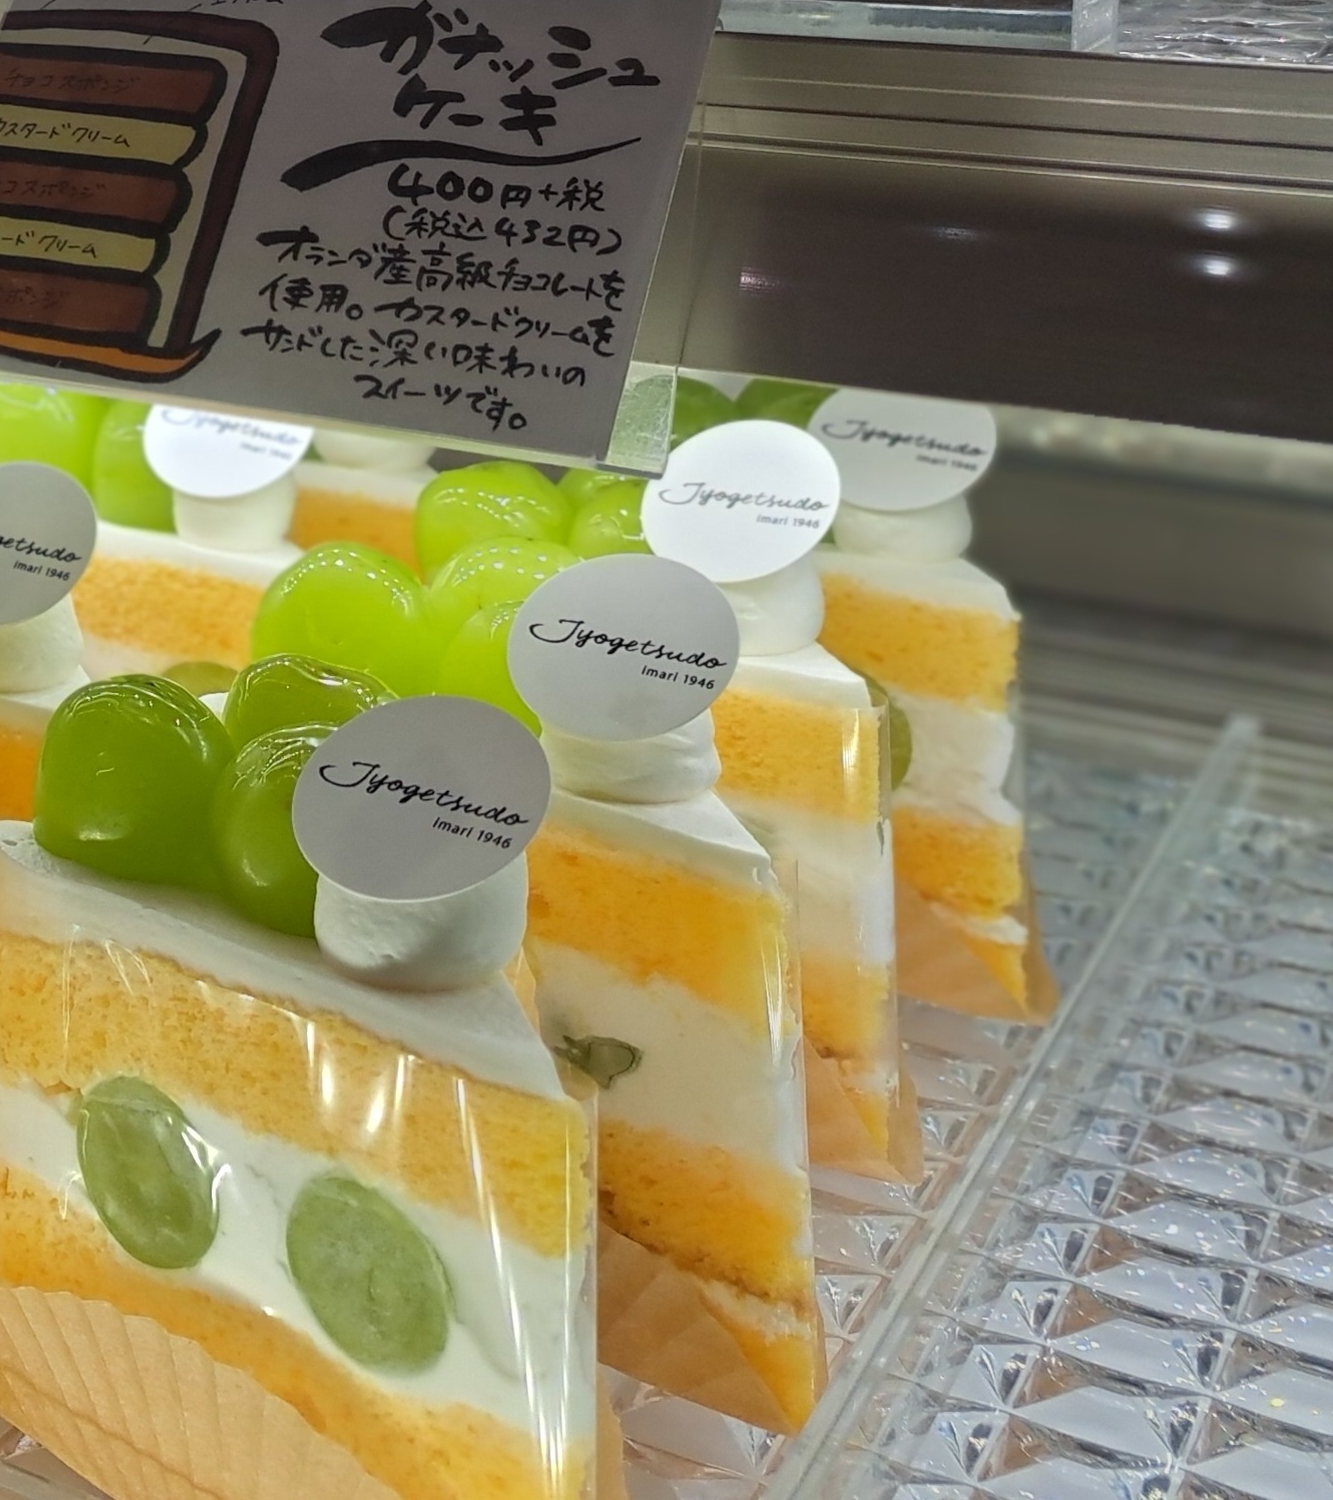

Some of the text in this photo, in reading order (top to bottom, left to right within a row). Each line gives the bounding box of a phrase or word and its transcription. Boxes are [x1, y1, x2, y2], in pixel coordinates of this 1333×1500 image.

[320, 0, 661, 90] ガナッシュ
[393, 73, 557, 146] ケーキ
[387, 163, 606, 211] 400円+税
[382, 205, 622, 255] (税込432円)
[256, 226, 626, 311] オランダ産高級チョコレートを
[258, 273, 615, 357] 使用。カスタードクリームを
[241, 319, 586, 387] サンドした深い味わいの
[354, 374, 527, 431] スイーツです。
[821, 419, 988, 458] Jyogetsudo
[658, 482, 830, 512] Jyogetsudo
[756, 514, 820, 530] imari 1946
[13, 560, 71, 582] imari 1946
[528, 619, 728, 670] Jyogetsudo
[641, 665, 715, 690] imari 1946
[319, 761, 529, 827] Jyogetsudo
[432, 816, 513, 850] imari 1946
